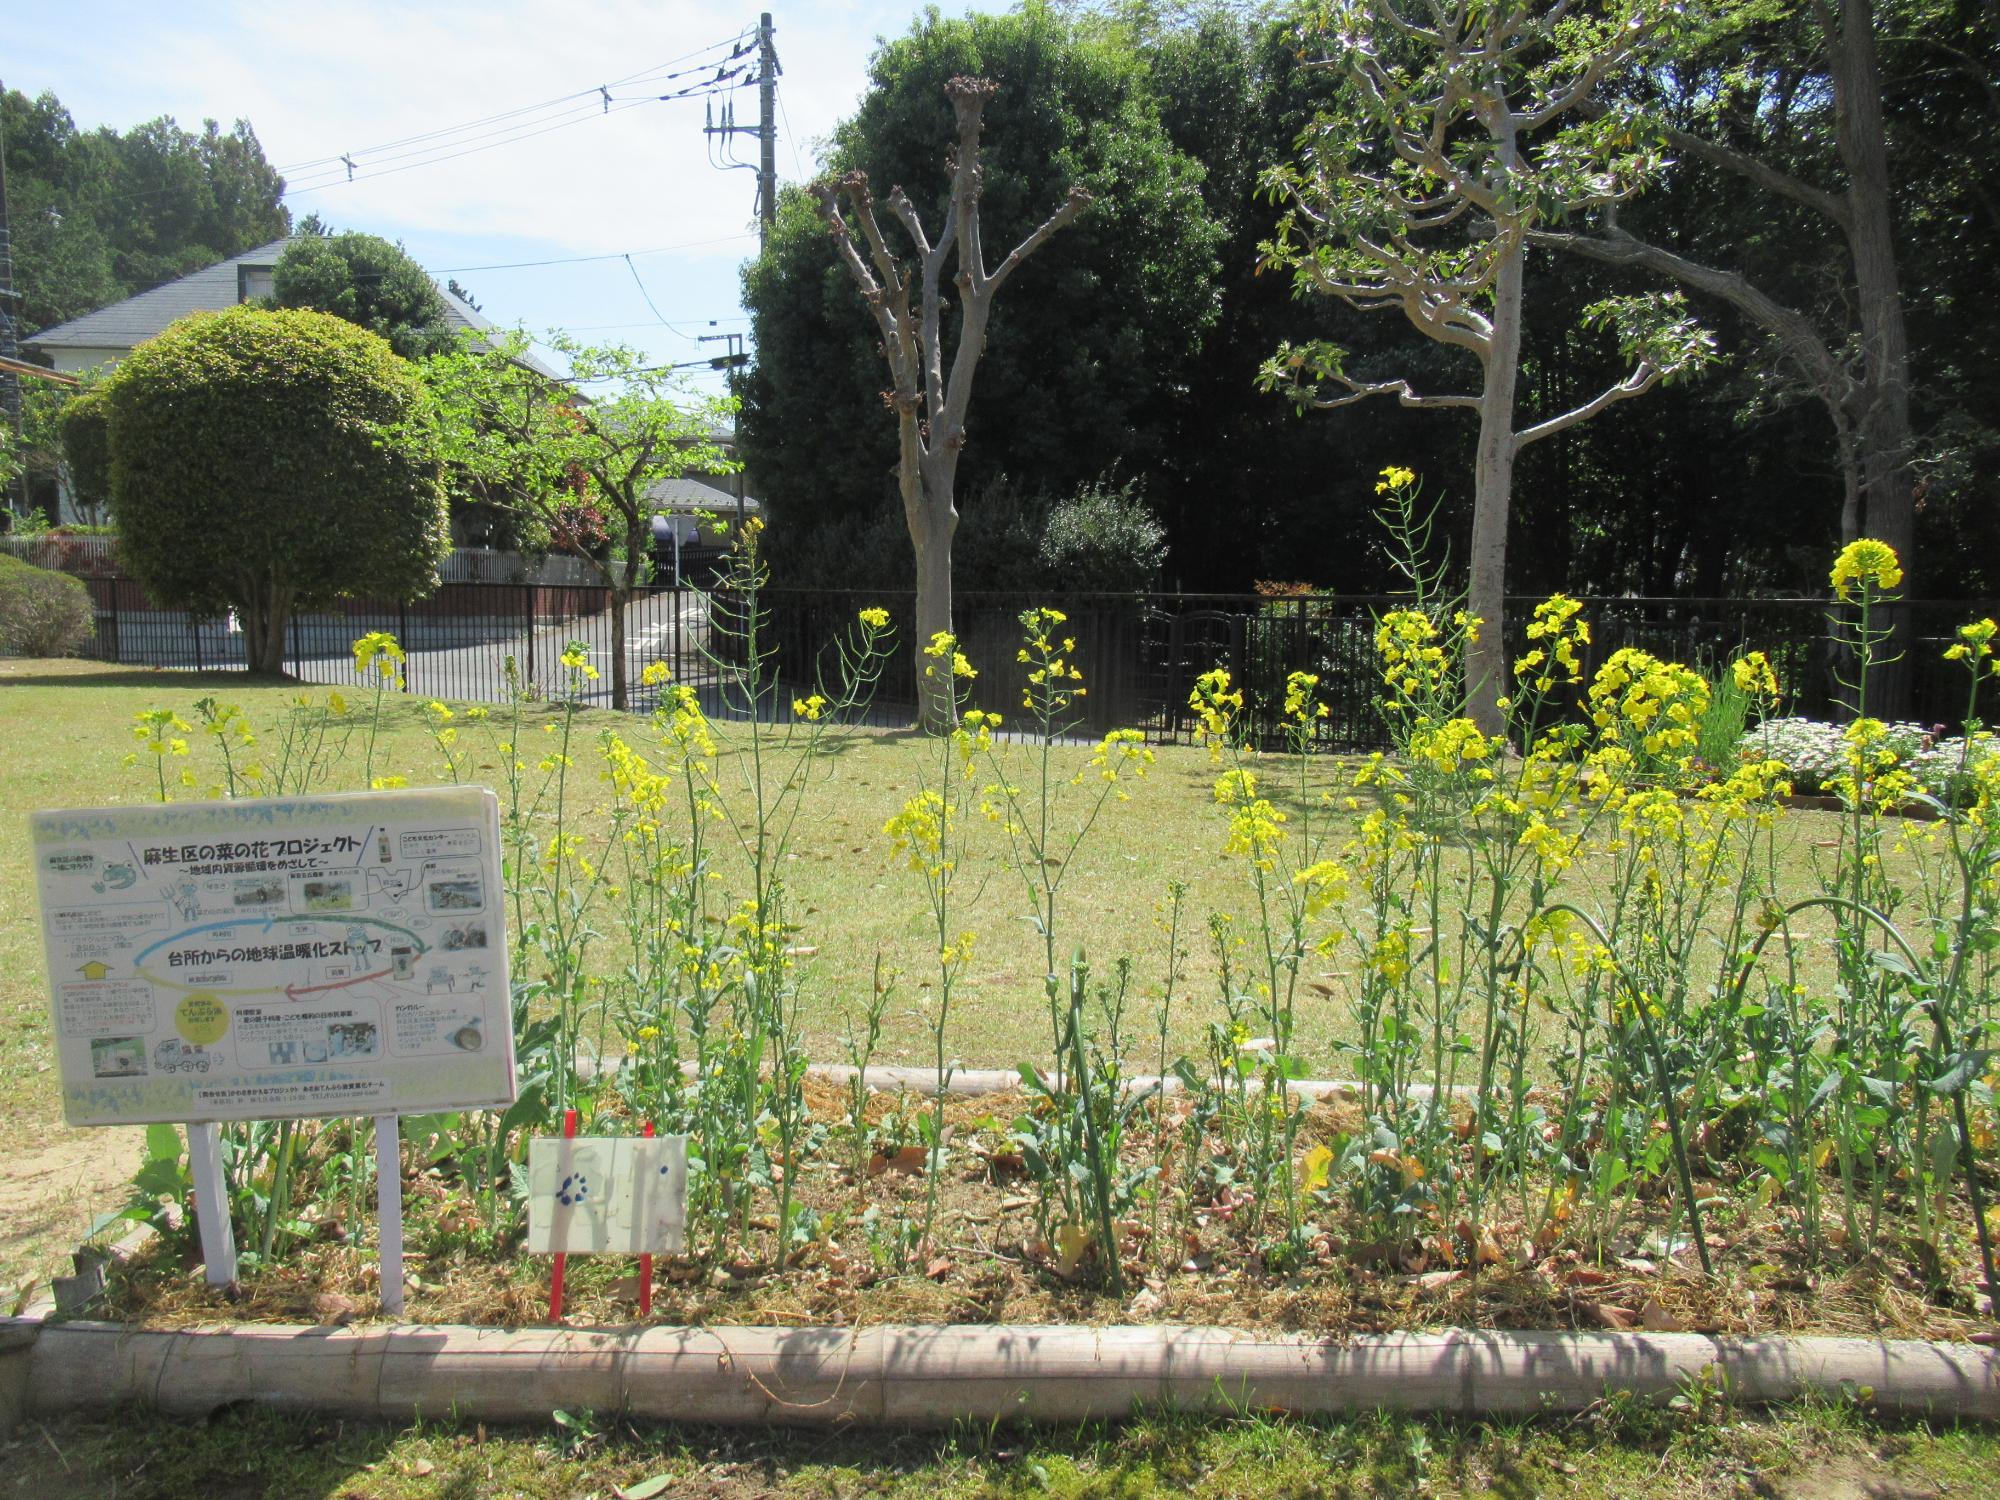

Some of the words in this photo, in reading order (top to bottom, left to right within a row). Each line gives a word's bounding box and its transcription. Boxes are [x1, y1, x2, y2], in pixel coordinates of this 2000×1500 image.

[144, 836, 362, 865] 麻生区の菜の花プロジェクト
